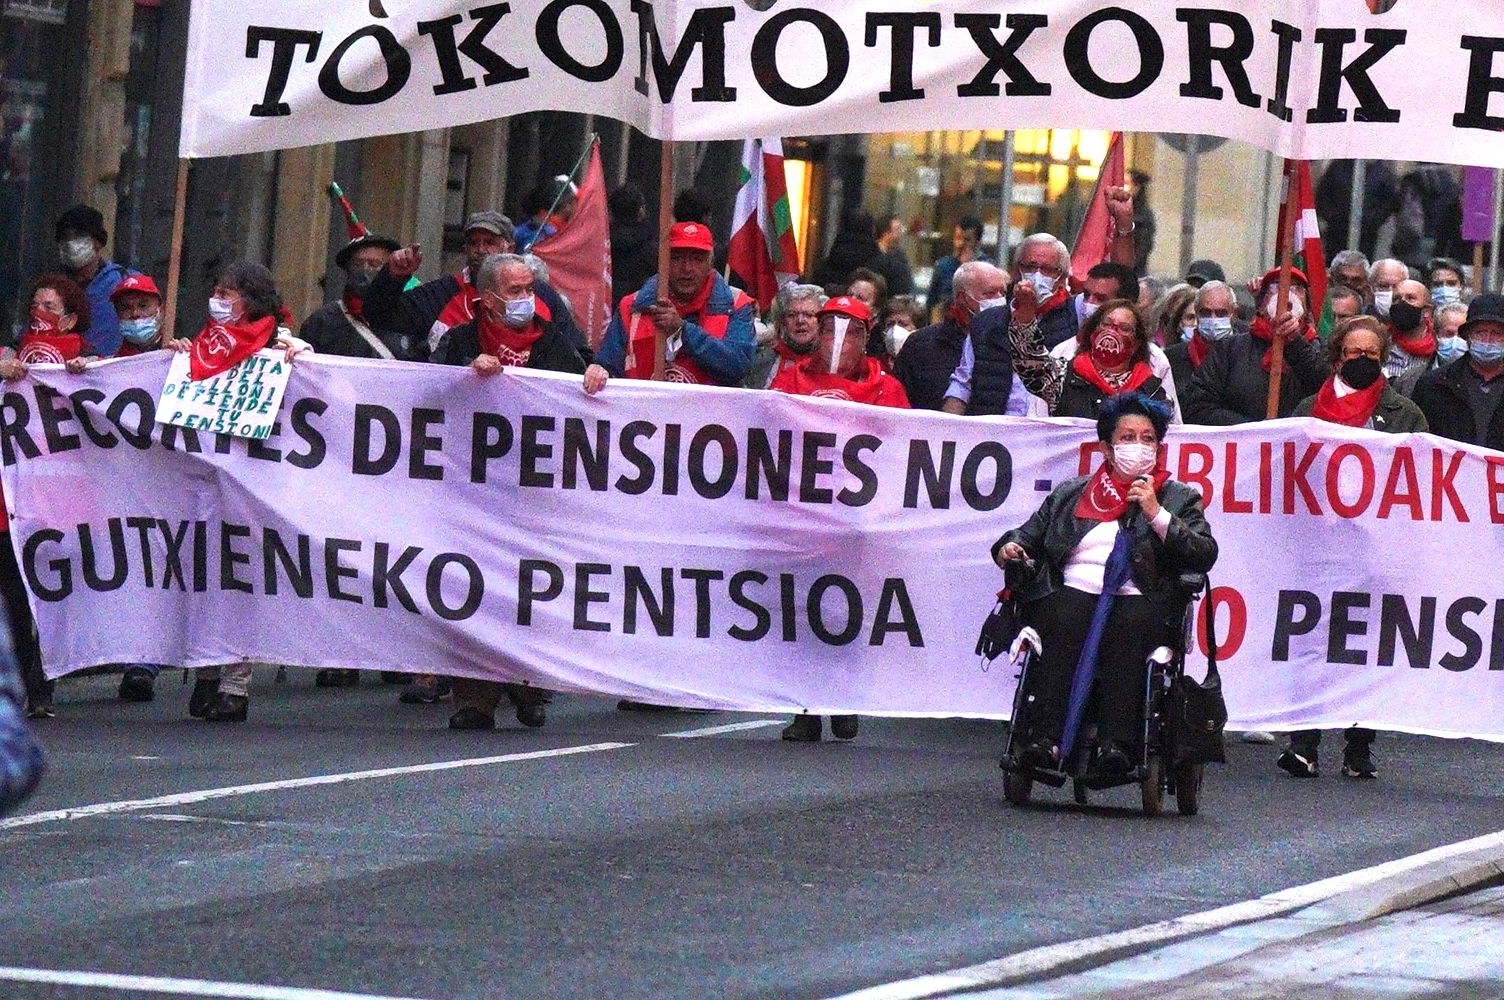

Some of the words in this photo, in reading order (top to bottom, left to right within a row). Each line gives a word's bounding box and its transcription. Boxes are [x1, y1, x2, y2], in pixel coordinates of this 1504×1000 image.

[227, 368, 264, 386] DEL
[217, 408, 241, 422] TU
[351, 404, 445, 482] DE
[469, 412, 883, 507] PENSIONES
[903, 439, 1012, 511] NO
[21, 515, 486, 621] GUTXIENEKO
[517, 559, 925, 648] PENTSIOA
